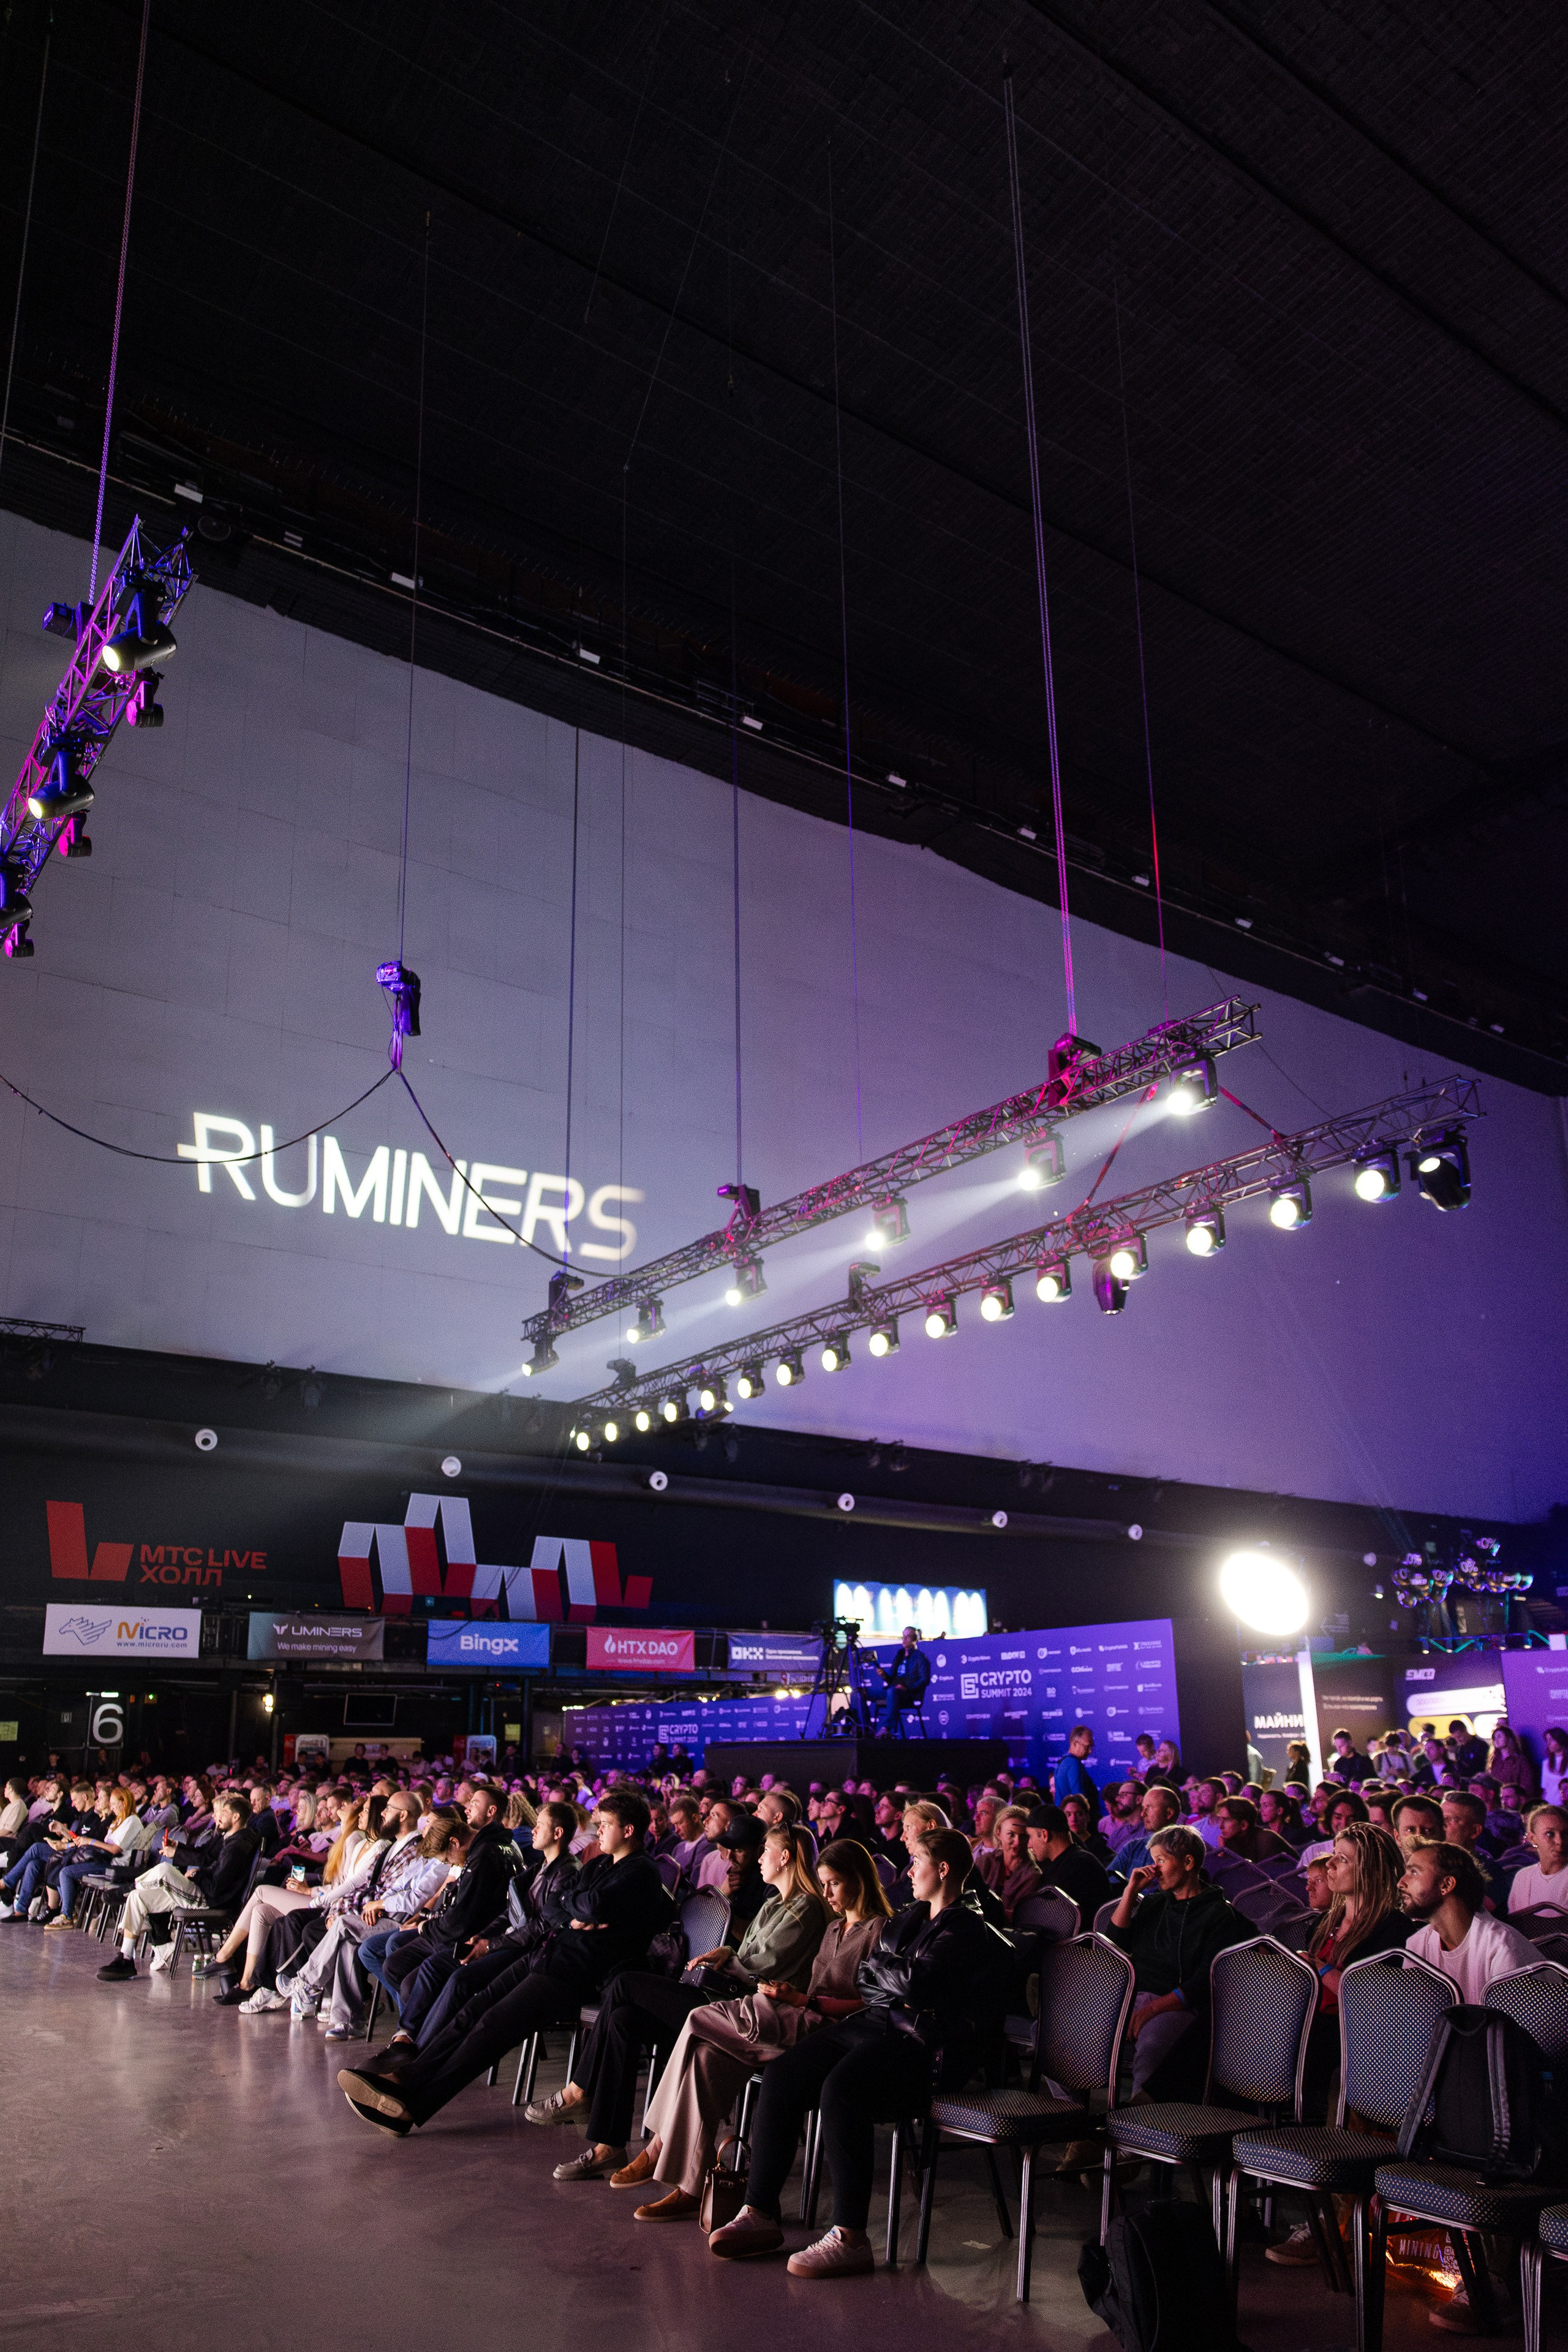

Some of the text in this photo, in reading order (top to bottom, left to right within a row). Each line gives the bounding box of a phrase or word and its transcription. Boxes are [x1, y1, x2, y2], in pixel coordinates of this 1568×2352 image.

[177, 1112, 646, 1261] RUMINERS
[140, 1544, 267, 1569] МТС LIVE
[138, 1564, 222, 1586] ХОЛЛ
[292, 1626, 363, 1637] UMINERS
[277, 1642, 290, 1651] We
[312, 1644, 337, 1654] mining
[339, 1645, 356, 1654] easy
[617, 1640, 678, 1655] HTX DAO
[731, 1646, 764, 1660] OKX
[980, 1669, 1032, 1686] CRYPTO
[981, 1687, 1032, 1698] SUMMIT 2024
[93, 1703, 123, 1744] 6
[1254, 1712, 1304, 1729] МАЙНИ
[669, 1724, 698, 1735] CRYPTO
